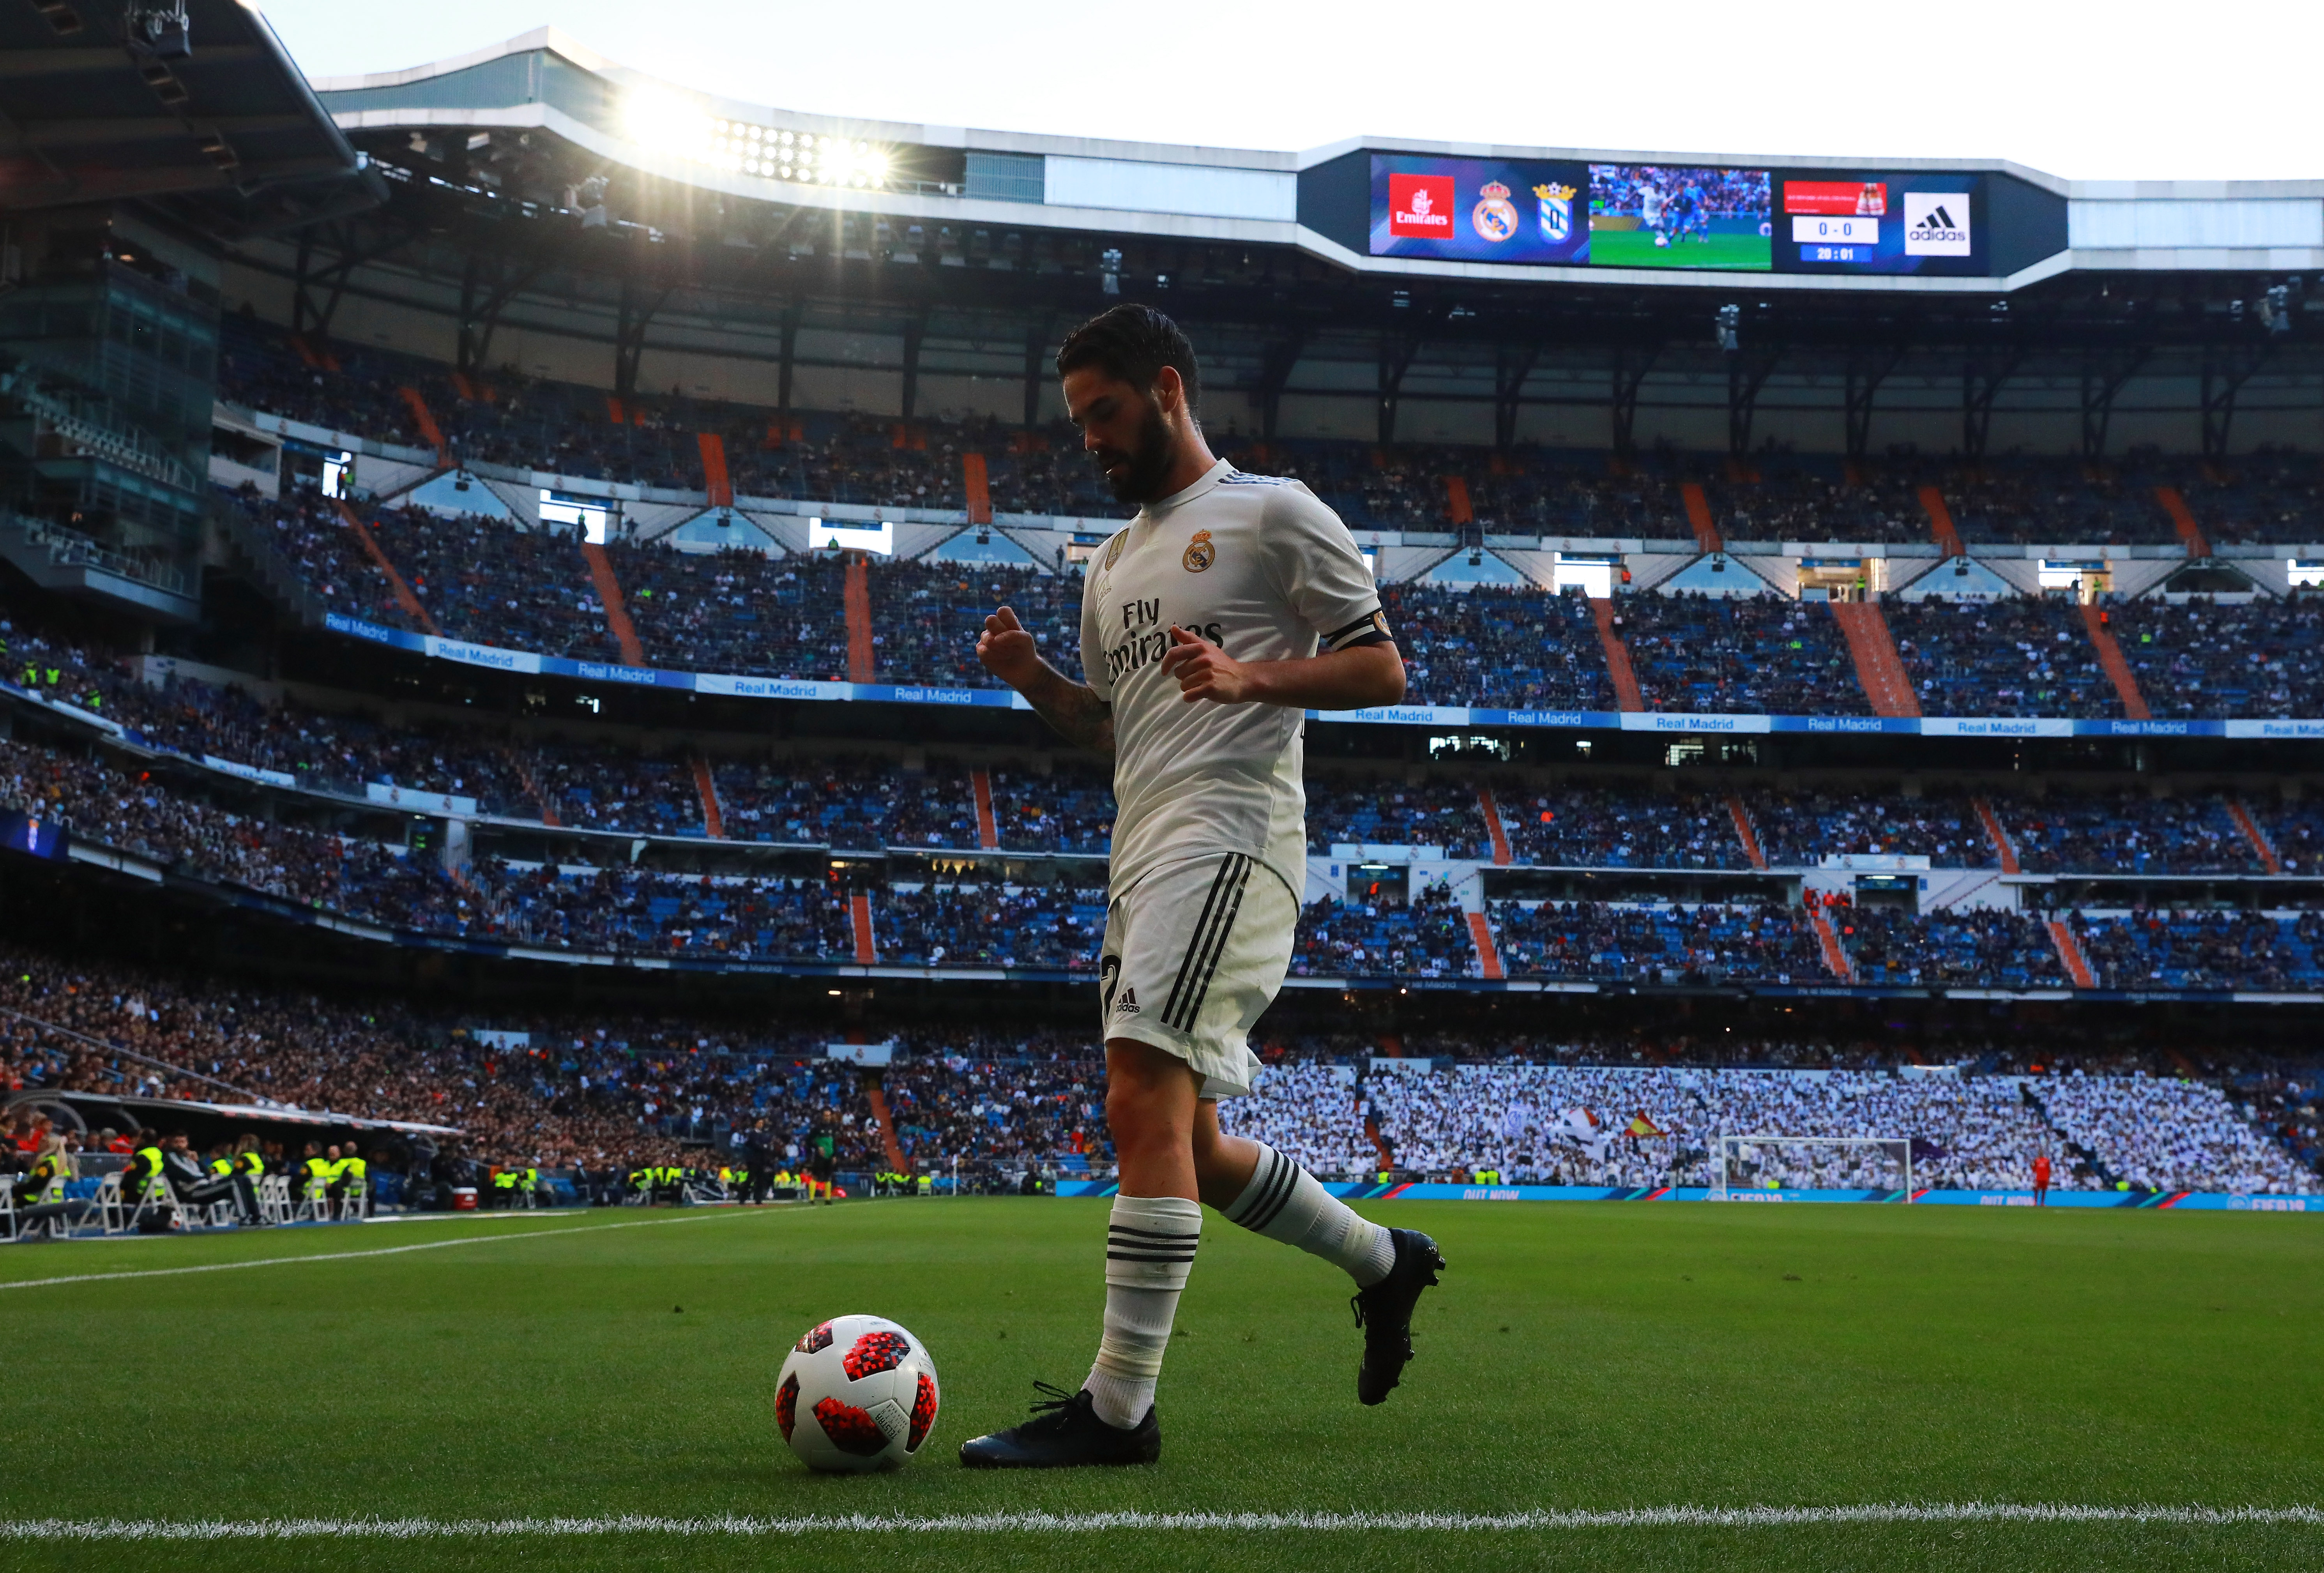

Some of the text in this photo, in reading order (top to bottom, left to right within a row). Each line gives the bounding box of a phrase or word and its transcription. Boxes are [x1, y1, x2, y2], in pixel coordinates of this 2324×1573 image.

[1396, 210, 1447, 226] Emirates
[1910, 228, 1966, 241] adidas
[1123, 598, 1159, 629] Fly
[578, 663, 656, 683] Real Madrid
[735, 682, 816, 696] Real Madrid
[895, 688, 972, 703] Real Madrid
[1356, 709, 1433, 721] Real Madrid
[1508, 711, 1581, 725] Real Madrid
[1657, 718, 1734, 729] Real Madrid
[1808, 718, 1882, 731] Real Madrid
[1958, 723, 2036, 733] Real Madrid
[1463, 1189, 1519, 1200] OUT NOW
[875, 1413, 897, 1439] TELSTAR
